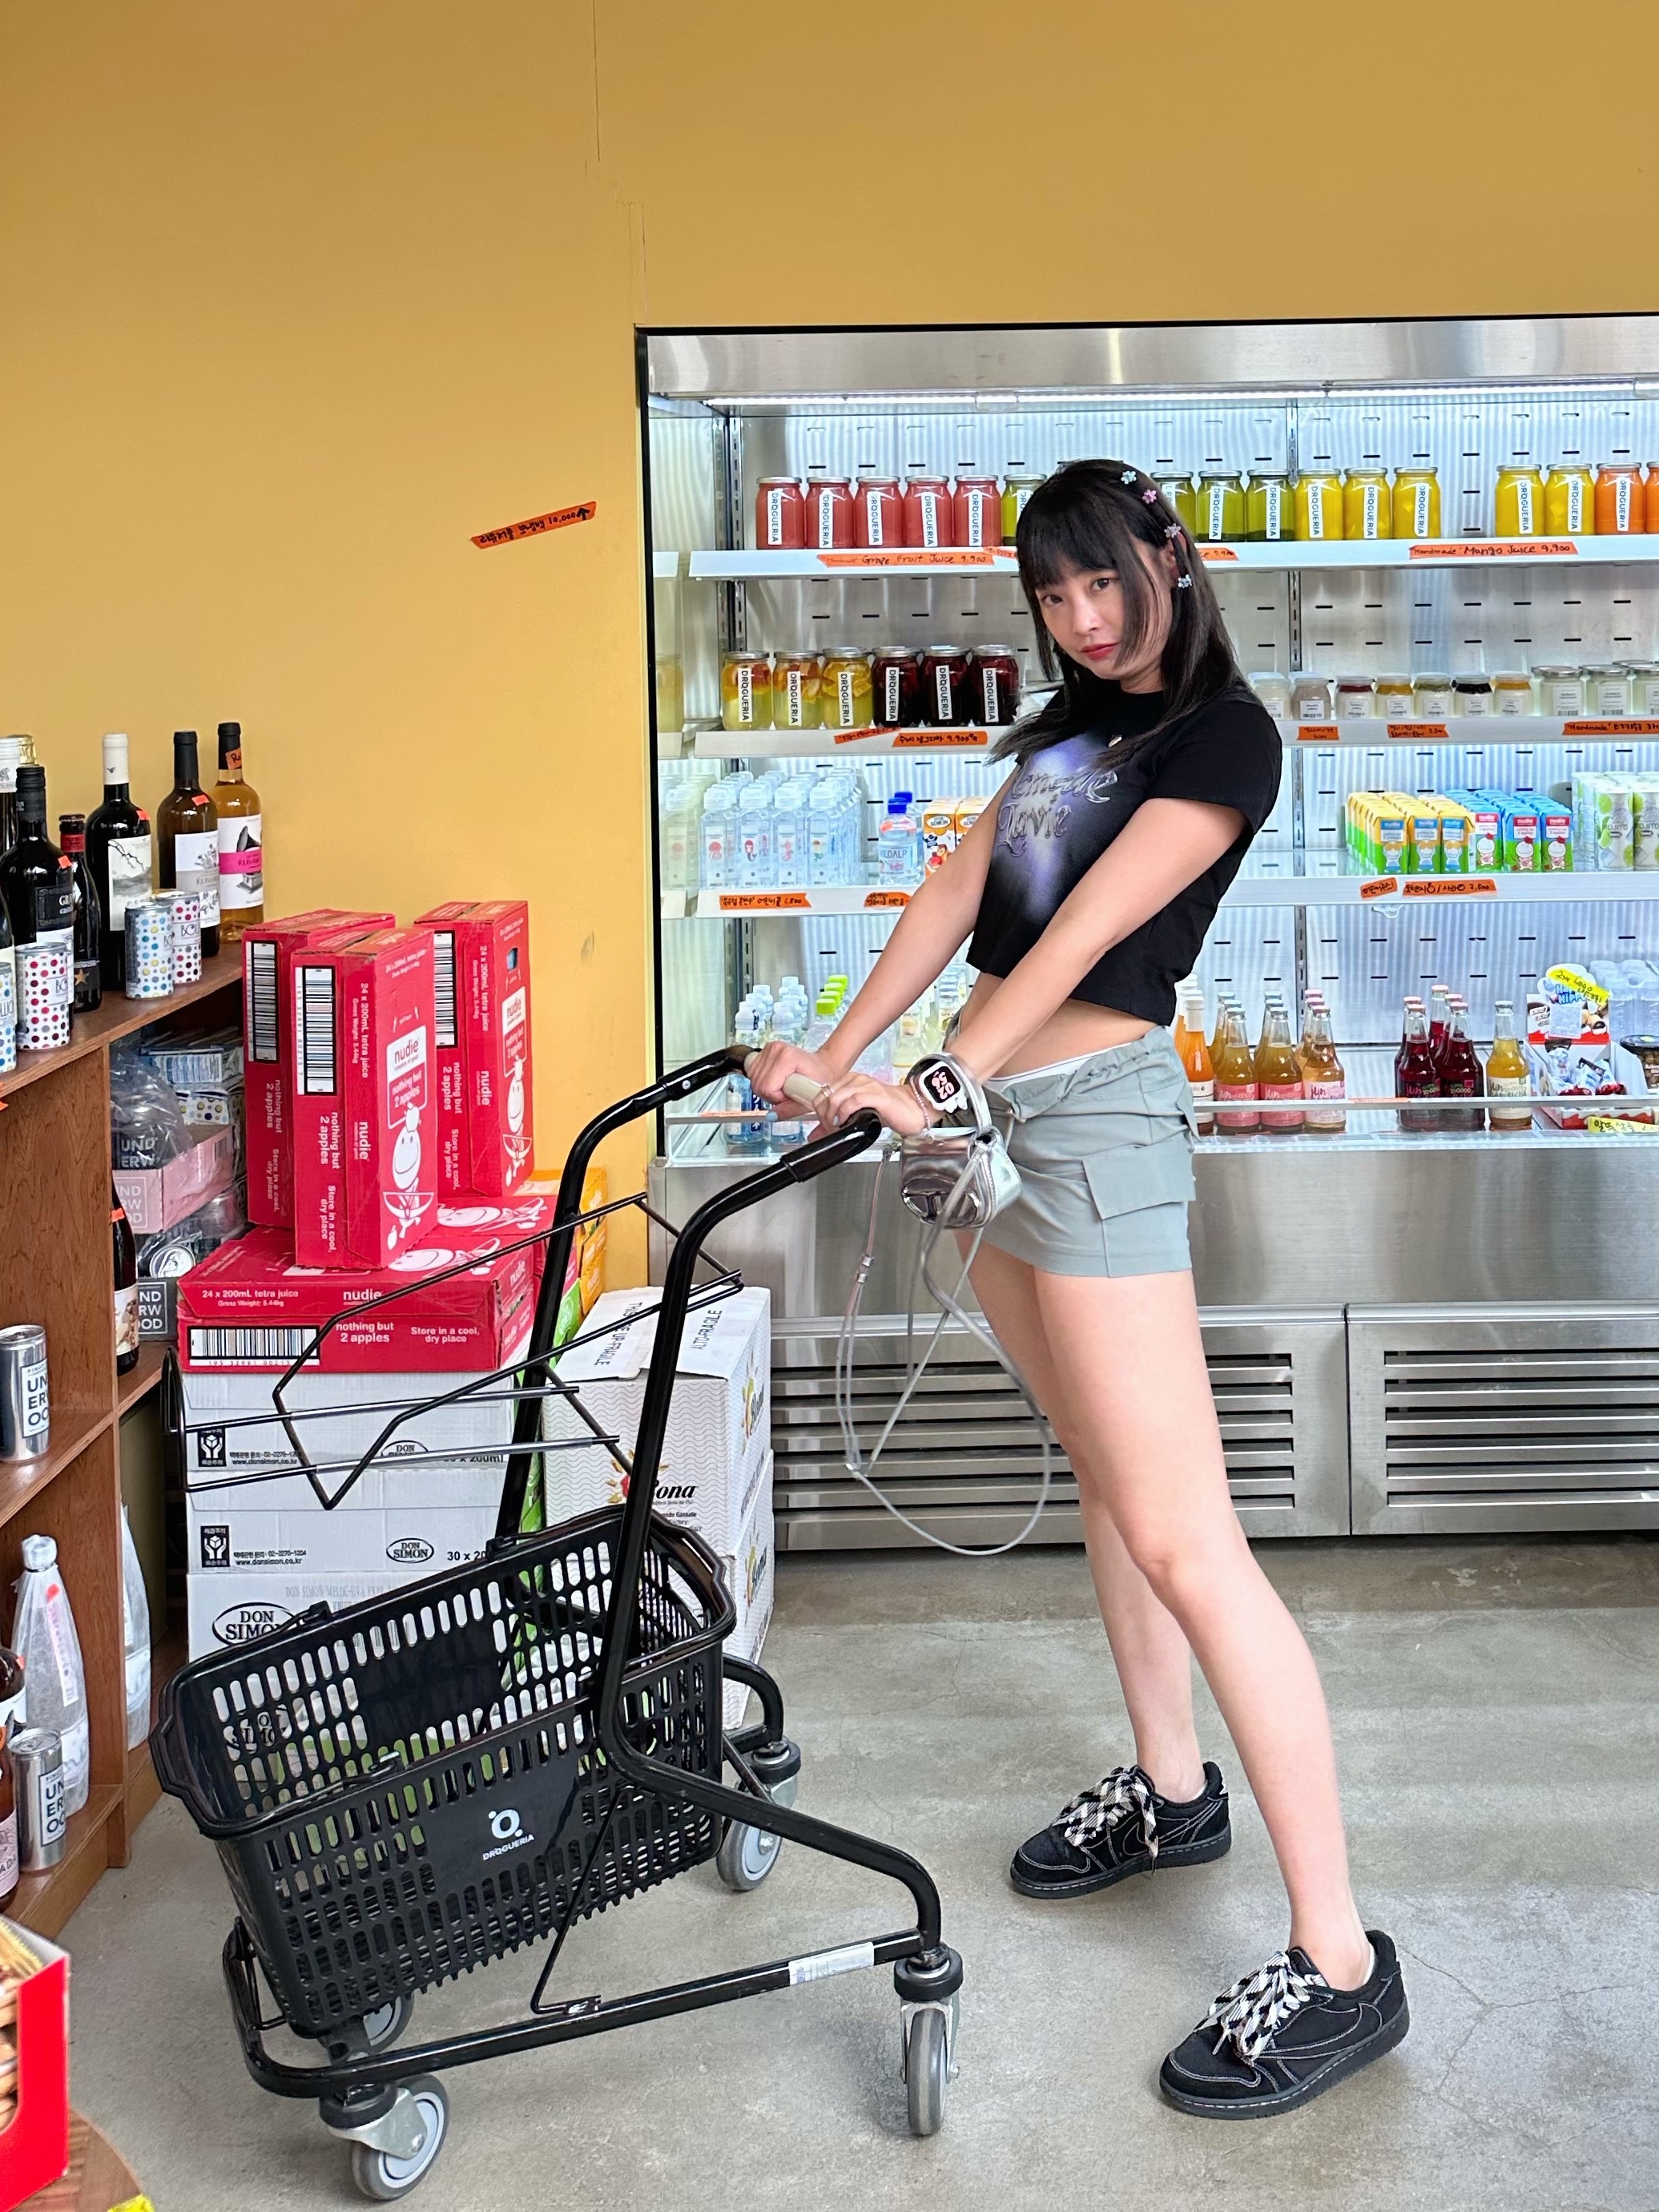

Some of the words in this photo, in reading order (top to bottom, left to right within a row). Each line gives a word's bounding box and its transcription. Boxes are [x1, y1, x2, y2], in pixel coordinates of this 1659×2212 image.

[861, 554, 891, 566] Grape
[896, 554, 923, 564] Fruit
[928, 554, 955, 563] Juice
[1463, 546, 1504, 556] Mango
[1507, 545, 1536, 554] Juice
[741, 670, 750, 721] DROGUERIA
[790, 672, 799, 725] DROGUERIA
[841, 673, 851, 725] DROGUERIA
[939, 667, 949, 719] DROGUERIA
[986, 668, 996, 721] DROGUERIA
[360, 982, 369, 994] 24
[361, 1003, 370, 1032] 200mL
[361, 1034, 370, 1056] tetra
[394, 1039, 419, 1065] nudie
[361, 1058, 371, 1078] juice
[442, 1066, 453, 1074] 2
[392, 1074, 413, 1096] nothing
[412, 1069, 423, 1085] but
[453, 1062, 462, 1098] nothing
[481, 1070, 493, 1106] nudie
[394, 1095, 401, 1108] 2
[400, 1085, 421, 1105] apples
[441, 1074, 453, 1111] apples
[265, 1092, 275, 1129] apples
[454, 1098, 463, 1114] but
[320, 1115, 330, 1124] 2
[329, 1111, 340, 1153] nothing
[358, 1122, 371, 1160] nudie
[451, 1128, 459, 1152] Store
[318, 1126, 330, 1165] apples
[331, 1153, 341, 1170] but
[452, 1153, 459, 1161] in
[320, 1199, 328, 1214] dry
[328, 1185, 336, 1211] Store
[328, 1211, 336, 1221] in
[319, 1215, 328, 1240] place
[139, 1291, 162, 1302] ND
[202, 1289, 214, 1298] 24
[222, 1289, 252, 1298] 200mL
[254, 1289, 276, 1298] tetra
[276, 1289, 299, 1299] juice
[343, 1289, 382, 1302] nudie
[139, 1304, 163, 1316] RW
[336, 1322, 375, 1332] nothing
[376, 1322, 394, 1331] but
[410, 1326, 436, 1336] Store
[437, 1327, 447, 1336] in
[457, 1327, 480, 1336] cool,
[340, 1332, 349, 1343] 2
[350, 1332, 390, 1344] apples
[425, 1335, 440, 1344] dry
[441, 1334, 467, 1344] place
[27, 1372, 48, 1392] UN
[28, 1392, 48, 1410] ER
[28, 1406, 49, 1426] OO
[396, 1444, 416, 1453] DON
[393, 1549, 429, 1559] SIMON
[401, 1541, 421, 1549] DON
[446, 1551, 461, 1561] 30
[240, 1610, 275, 1623] DON
[225, 1623, 281, 1640] SIMO
[46, 1780, 64, 1800] UN
[46, 1797, 64, 1818] ER
[46, 1813, 66, 1834] OO
[482, 1834, 535, 1861] DROGUERIA
